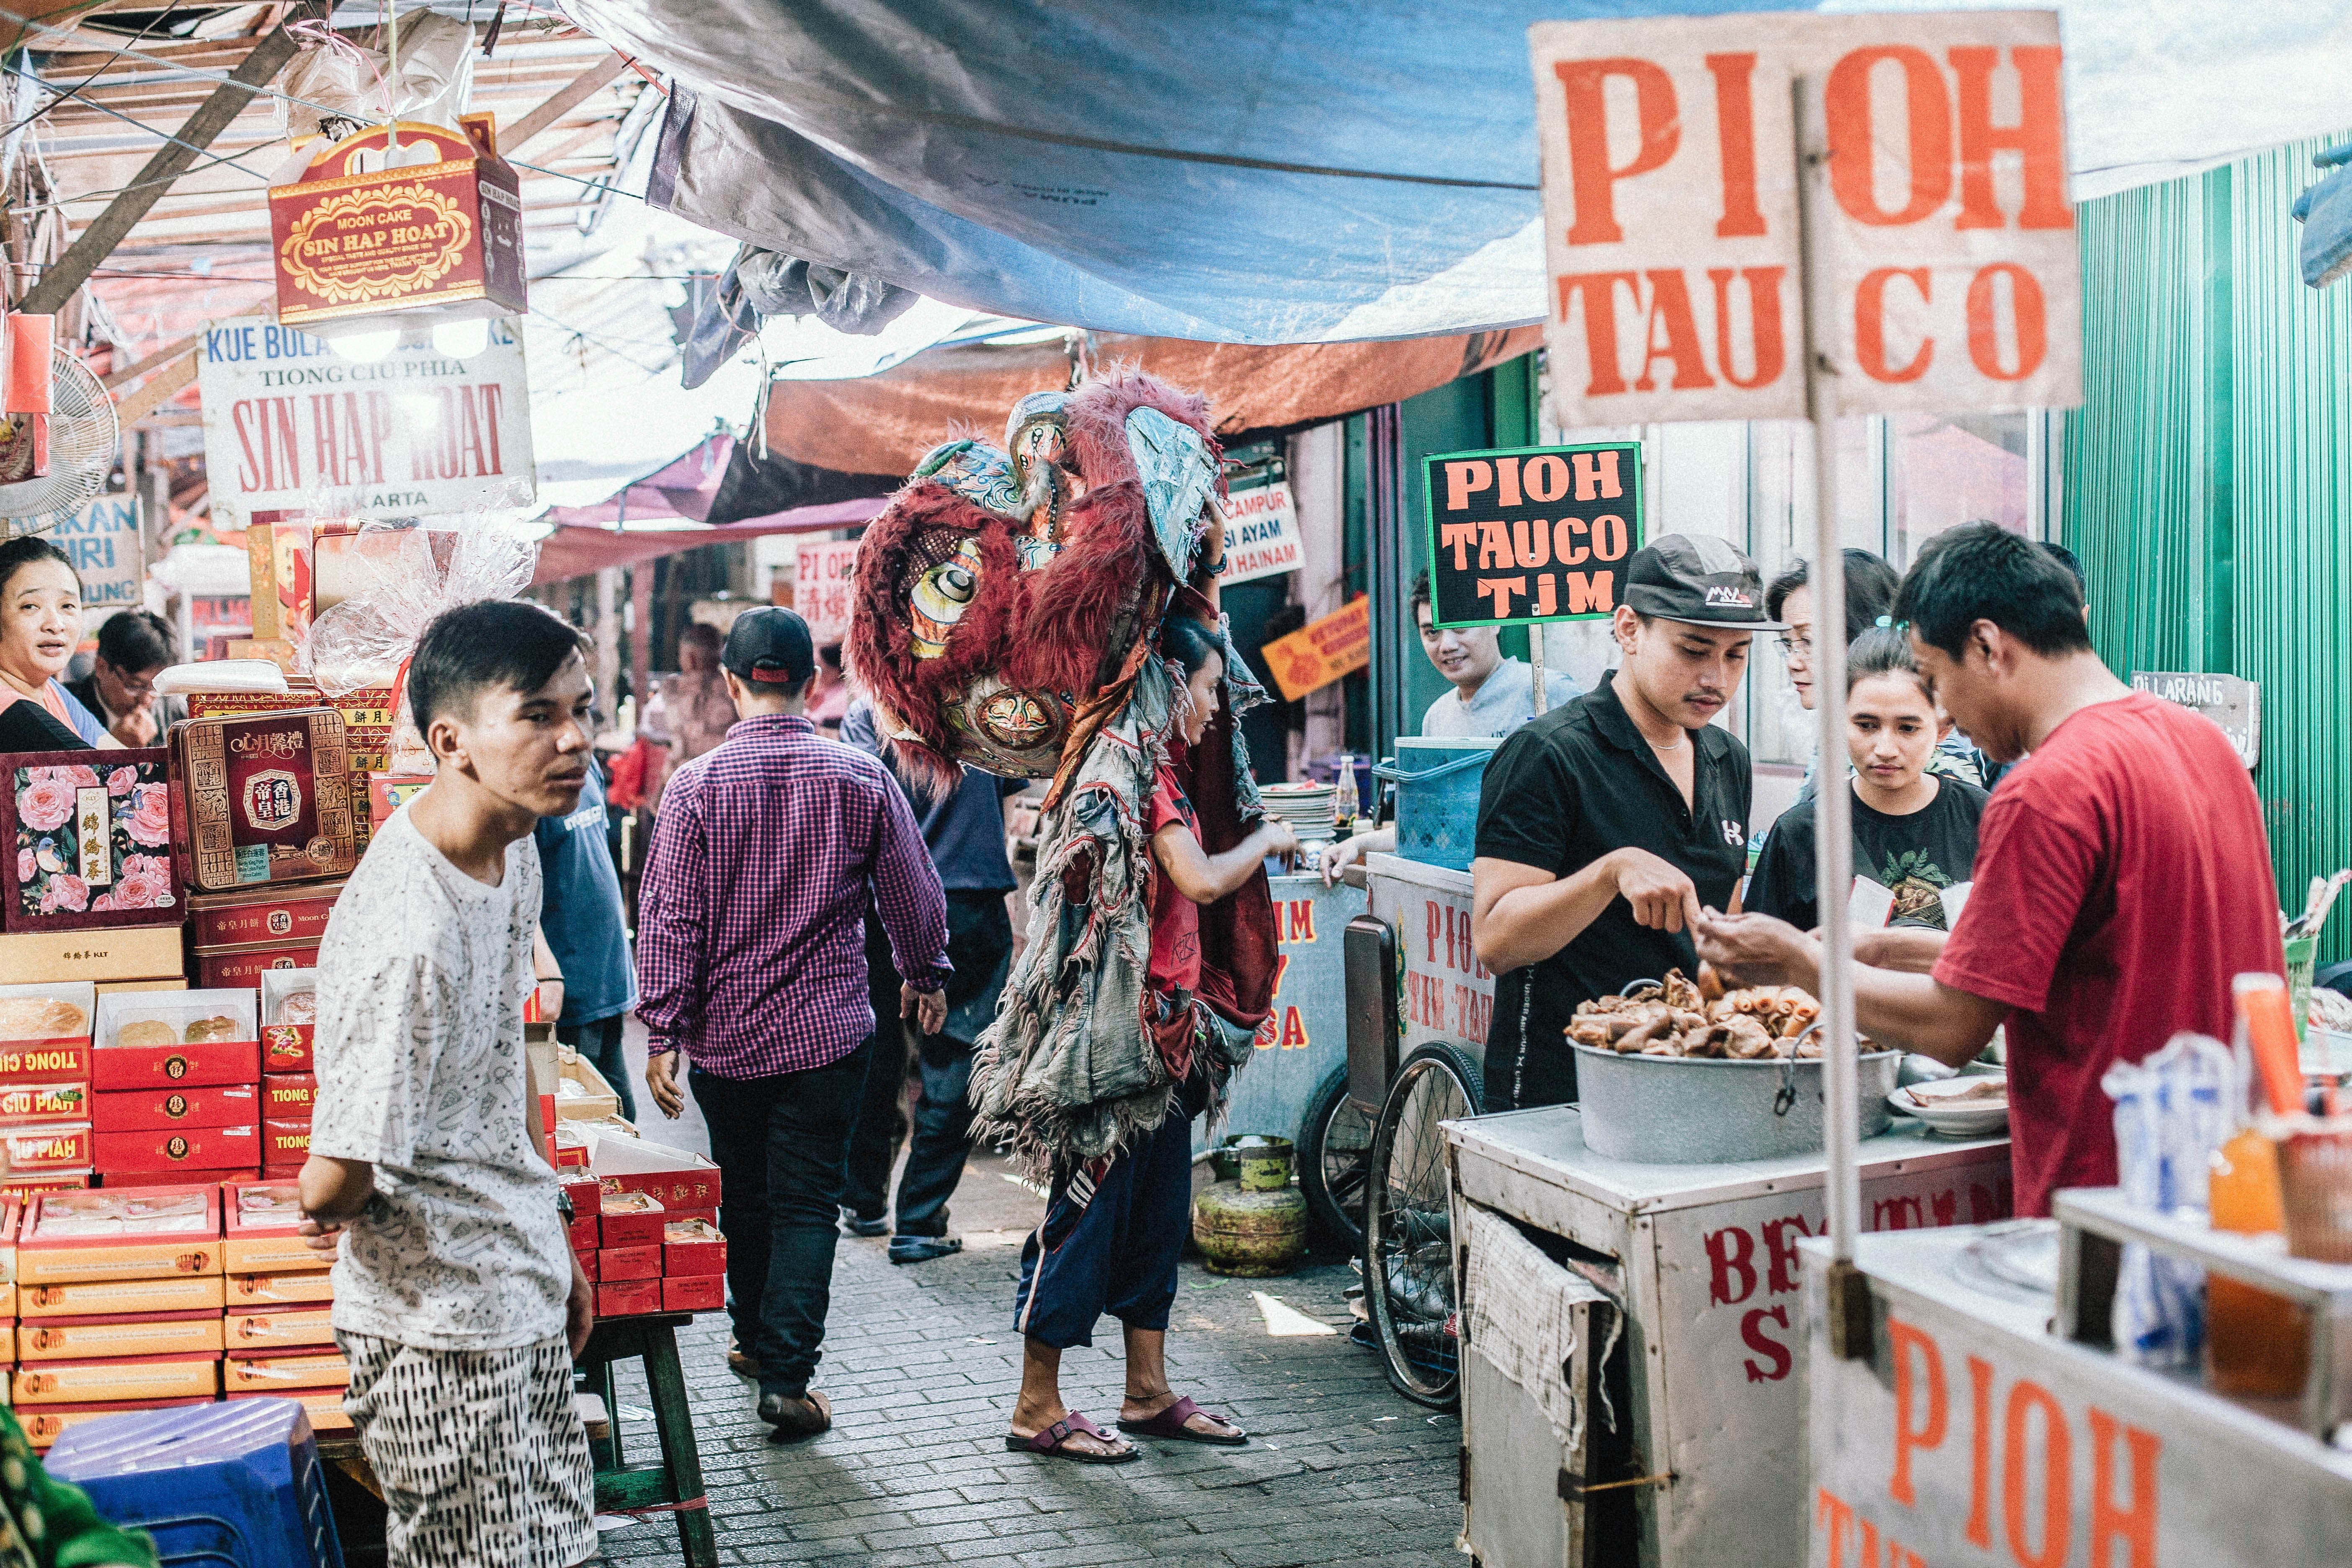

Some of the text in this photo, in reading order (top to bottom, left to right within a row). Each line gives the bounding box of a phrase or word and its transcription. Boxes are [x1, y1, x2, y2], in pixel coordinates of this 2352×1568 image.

[338, 209, 412, 230] MOON CAKE
[304, 222, 449, 257] SIN HAP HOAT
[207, 326, 255, 363] KUE
[264, 325, 330, 360] BULA
[259, 359, 466, 387] TIONG CIU PHIA
[233, 396, 301, 493] SIN
[309, 390, 393, 488] HAP
[1444, 450, 1622, 511] PIOH
[1224, 491, 1287, 519] CAMPUR
[1243, 519, 1282, 544] AYAM
[1441, 515, 1628, 570] TAUCO
[1236, 544, 1296, 573] HAINAM
[311, 714, 340, 725] HONG
[312, 723, 341, 735] KONG
[255, 781, 291, 818] 香港 帝皇
[201, 851, 232, 864] HONG
[202, 861, 232, 874] KONG
[217, 918, 260, 931] 帝皇月餅
[1426, 900, 1491, 980] PIO
[25, 1051, 77, 1071] TIONG
[272, 1088, 309, 1102] TIONG
[37, 1139, 76, 1158] PIAH
[276, 1135, 311, 1149] TIONG
[1703, 1213, 1827, 1309] BE
[1888, 1316, 2162, 1568] PIOH
[1815, 1485, 1929, 1568] TI
